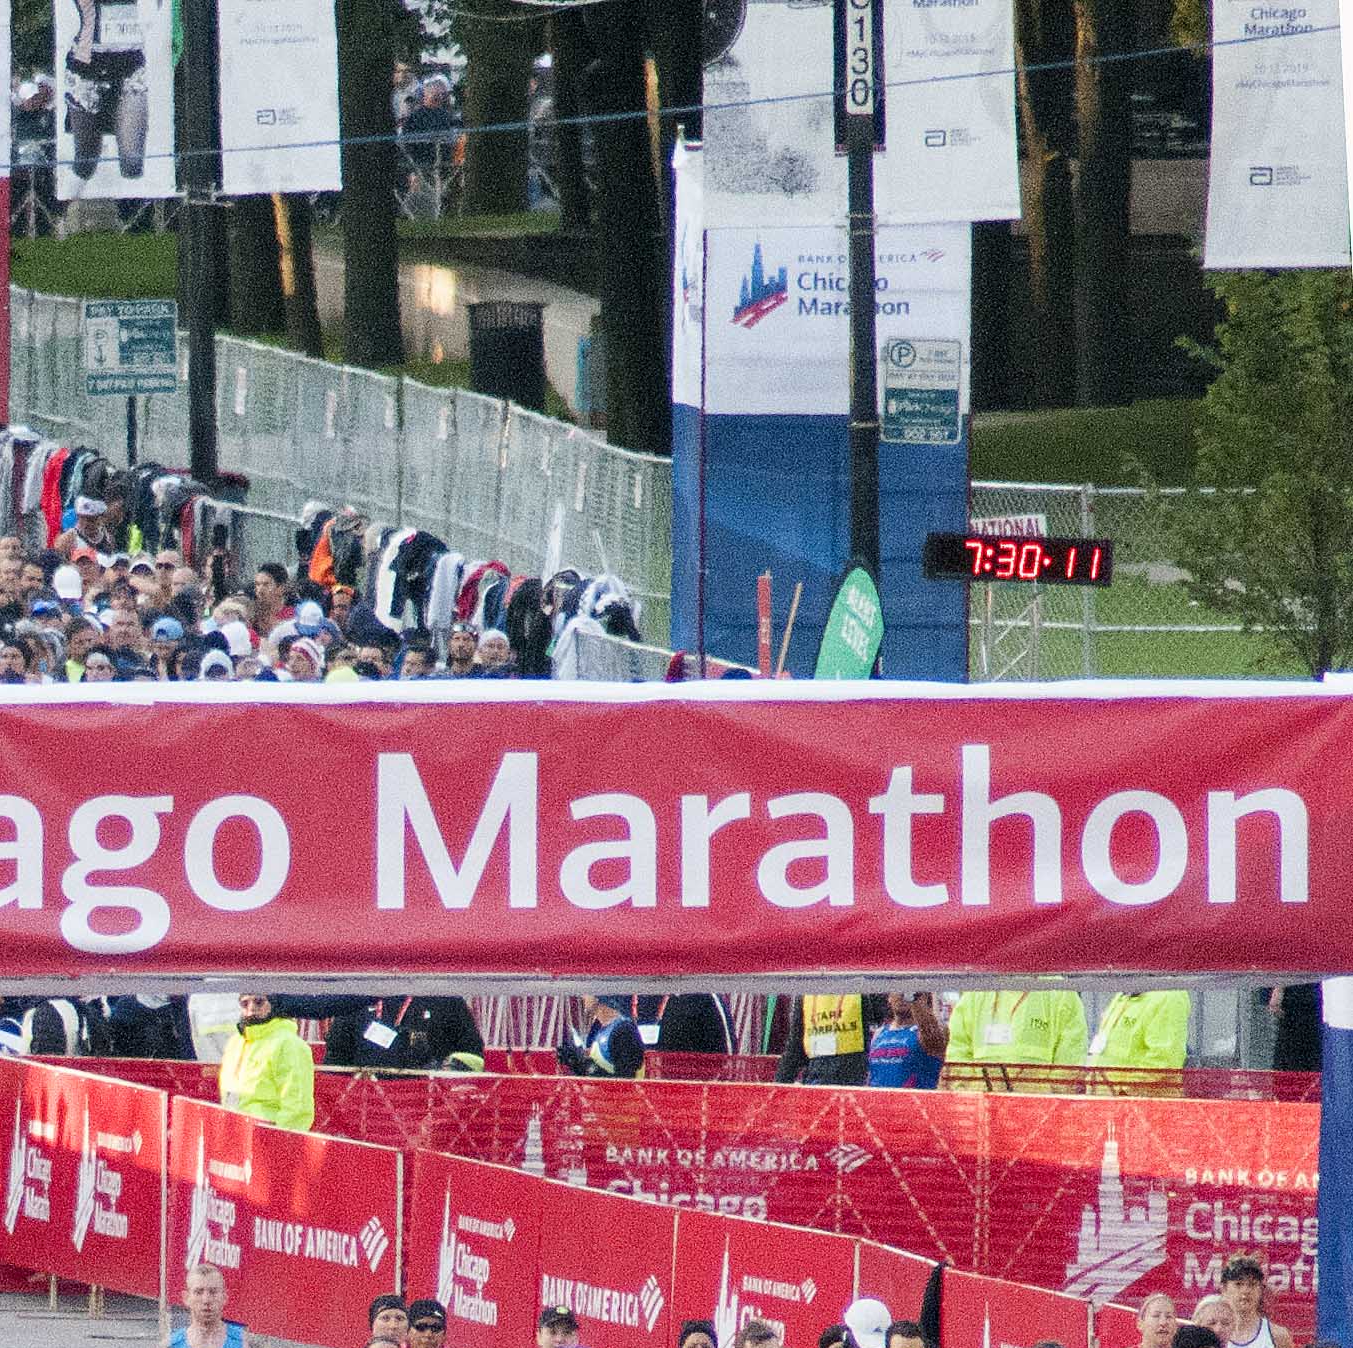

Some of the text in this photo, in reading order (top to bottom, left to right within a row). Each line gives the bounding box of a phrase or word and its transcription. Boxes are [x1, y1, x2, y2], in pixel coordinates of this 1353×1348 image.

[1250, 8, 1306, 22] Chicago
[797, 271, 889, 292] Chico
[798, 297, 910, 316] Maraon
[377, 742, 1312, 912] Marathon
[605, 1146, 669, 1166] BANK
[711, 1149, 819, 1172] AMERICA
[1185, 1167, 1288, 1187] BANK OF
[1184, 1202, 1319, 1256] Chicag
[254, 1217, 359, 1268] BANK OF AMERICA
[542, 1273, 574, 1309] BANK
